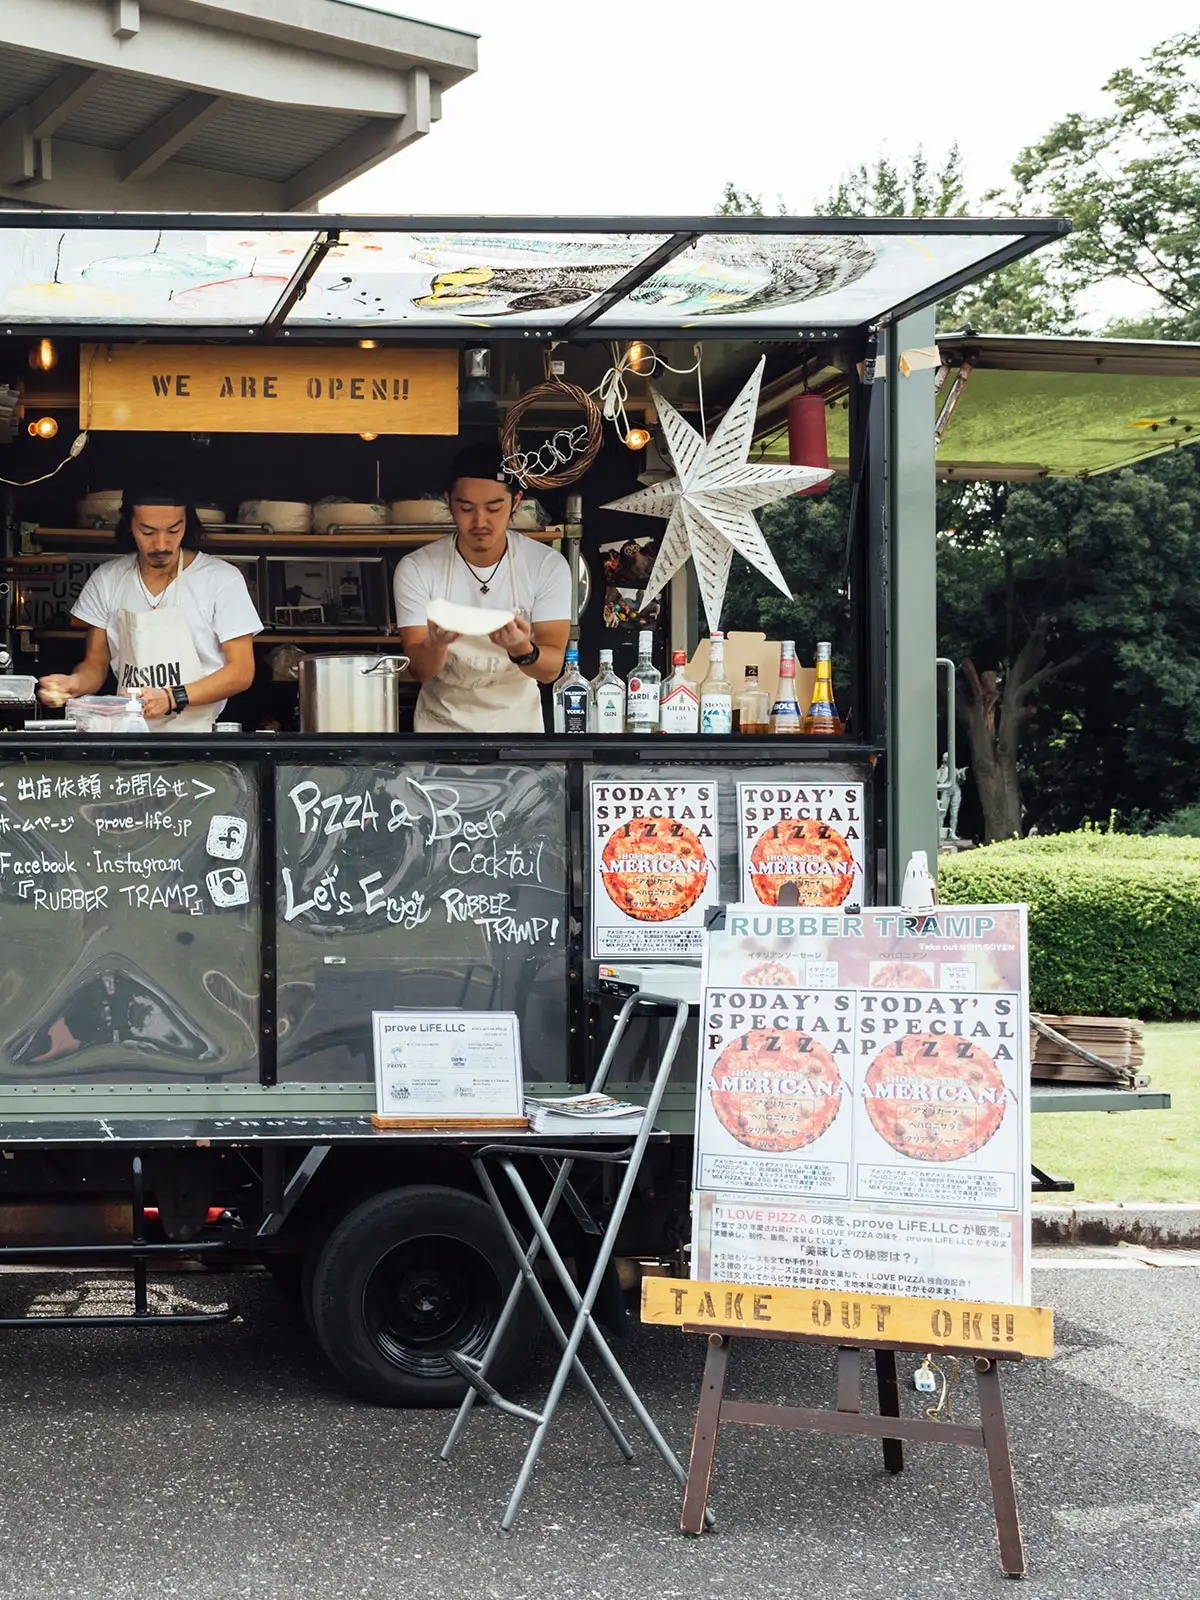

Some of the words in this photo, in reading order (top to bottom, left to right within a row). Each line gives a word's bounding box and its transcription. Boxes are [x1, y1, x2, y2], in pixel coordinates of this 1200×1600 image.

[152, 374, 190, 398] WE
[219, 375, 278, 399] ARE
[306, 376, 409, 401] OPEN!!
[405, 776, 507, 847] Beer
[597, 805, 712, 819] SPECIAL
[745, 807, 860, 821] SPECIAL
[95, 812, 192, 837] prove-life.jp
[598, 823, 713, 838] PIZZA
[746, 825, 860, 840] PIZZA
[0, 850, 78, 874] Facebook
[449, 841, 544, 883] Cocktail
[598, 859, 716, 873] AMERICANA
[748, 861, 863, 875] AMERICANA
[358, 871, 432, 930] Enjoy
[474, 917, 560, 946] TRAMP!
[730, 916, 863, 938] RUBBER
[876, 916, 995, 939] TRAMP
[919, 943, 941, 951] Take
[384, 1023, 417, 1033] prove
[709, 1014, 852, 1032] SPECIAL
[860, 1018, 1014, 1038] SPECIAL
[709, 1034, 851, 1055] PIZZA
[861, 1040, 1013, 1061] PIZZA
[706, 1078, 853, 1097] AMERICANA
[861, 1083, 1018, 1105] AMERICANA
[728, 1209, 763, 1221] LOVE
[768, 1211, 807, 1224] PIZZA
[852, 1219, 894, 1230] prove
[898, 1220, 958, 1234] LiFE.LLC
[821, 1228, 845, 1237] LOVE
[847, 1230, 874, 1239] PIZZA
[871, 1272, 895, 1281] LOVE
[898, 1274, 925, 1284] PIZZA
[668, 1286, 774, 1322] TAKE
[810, 1297, 892, 1333] OUT
[930, 1307, 1016, 1343] OK!!
